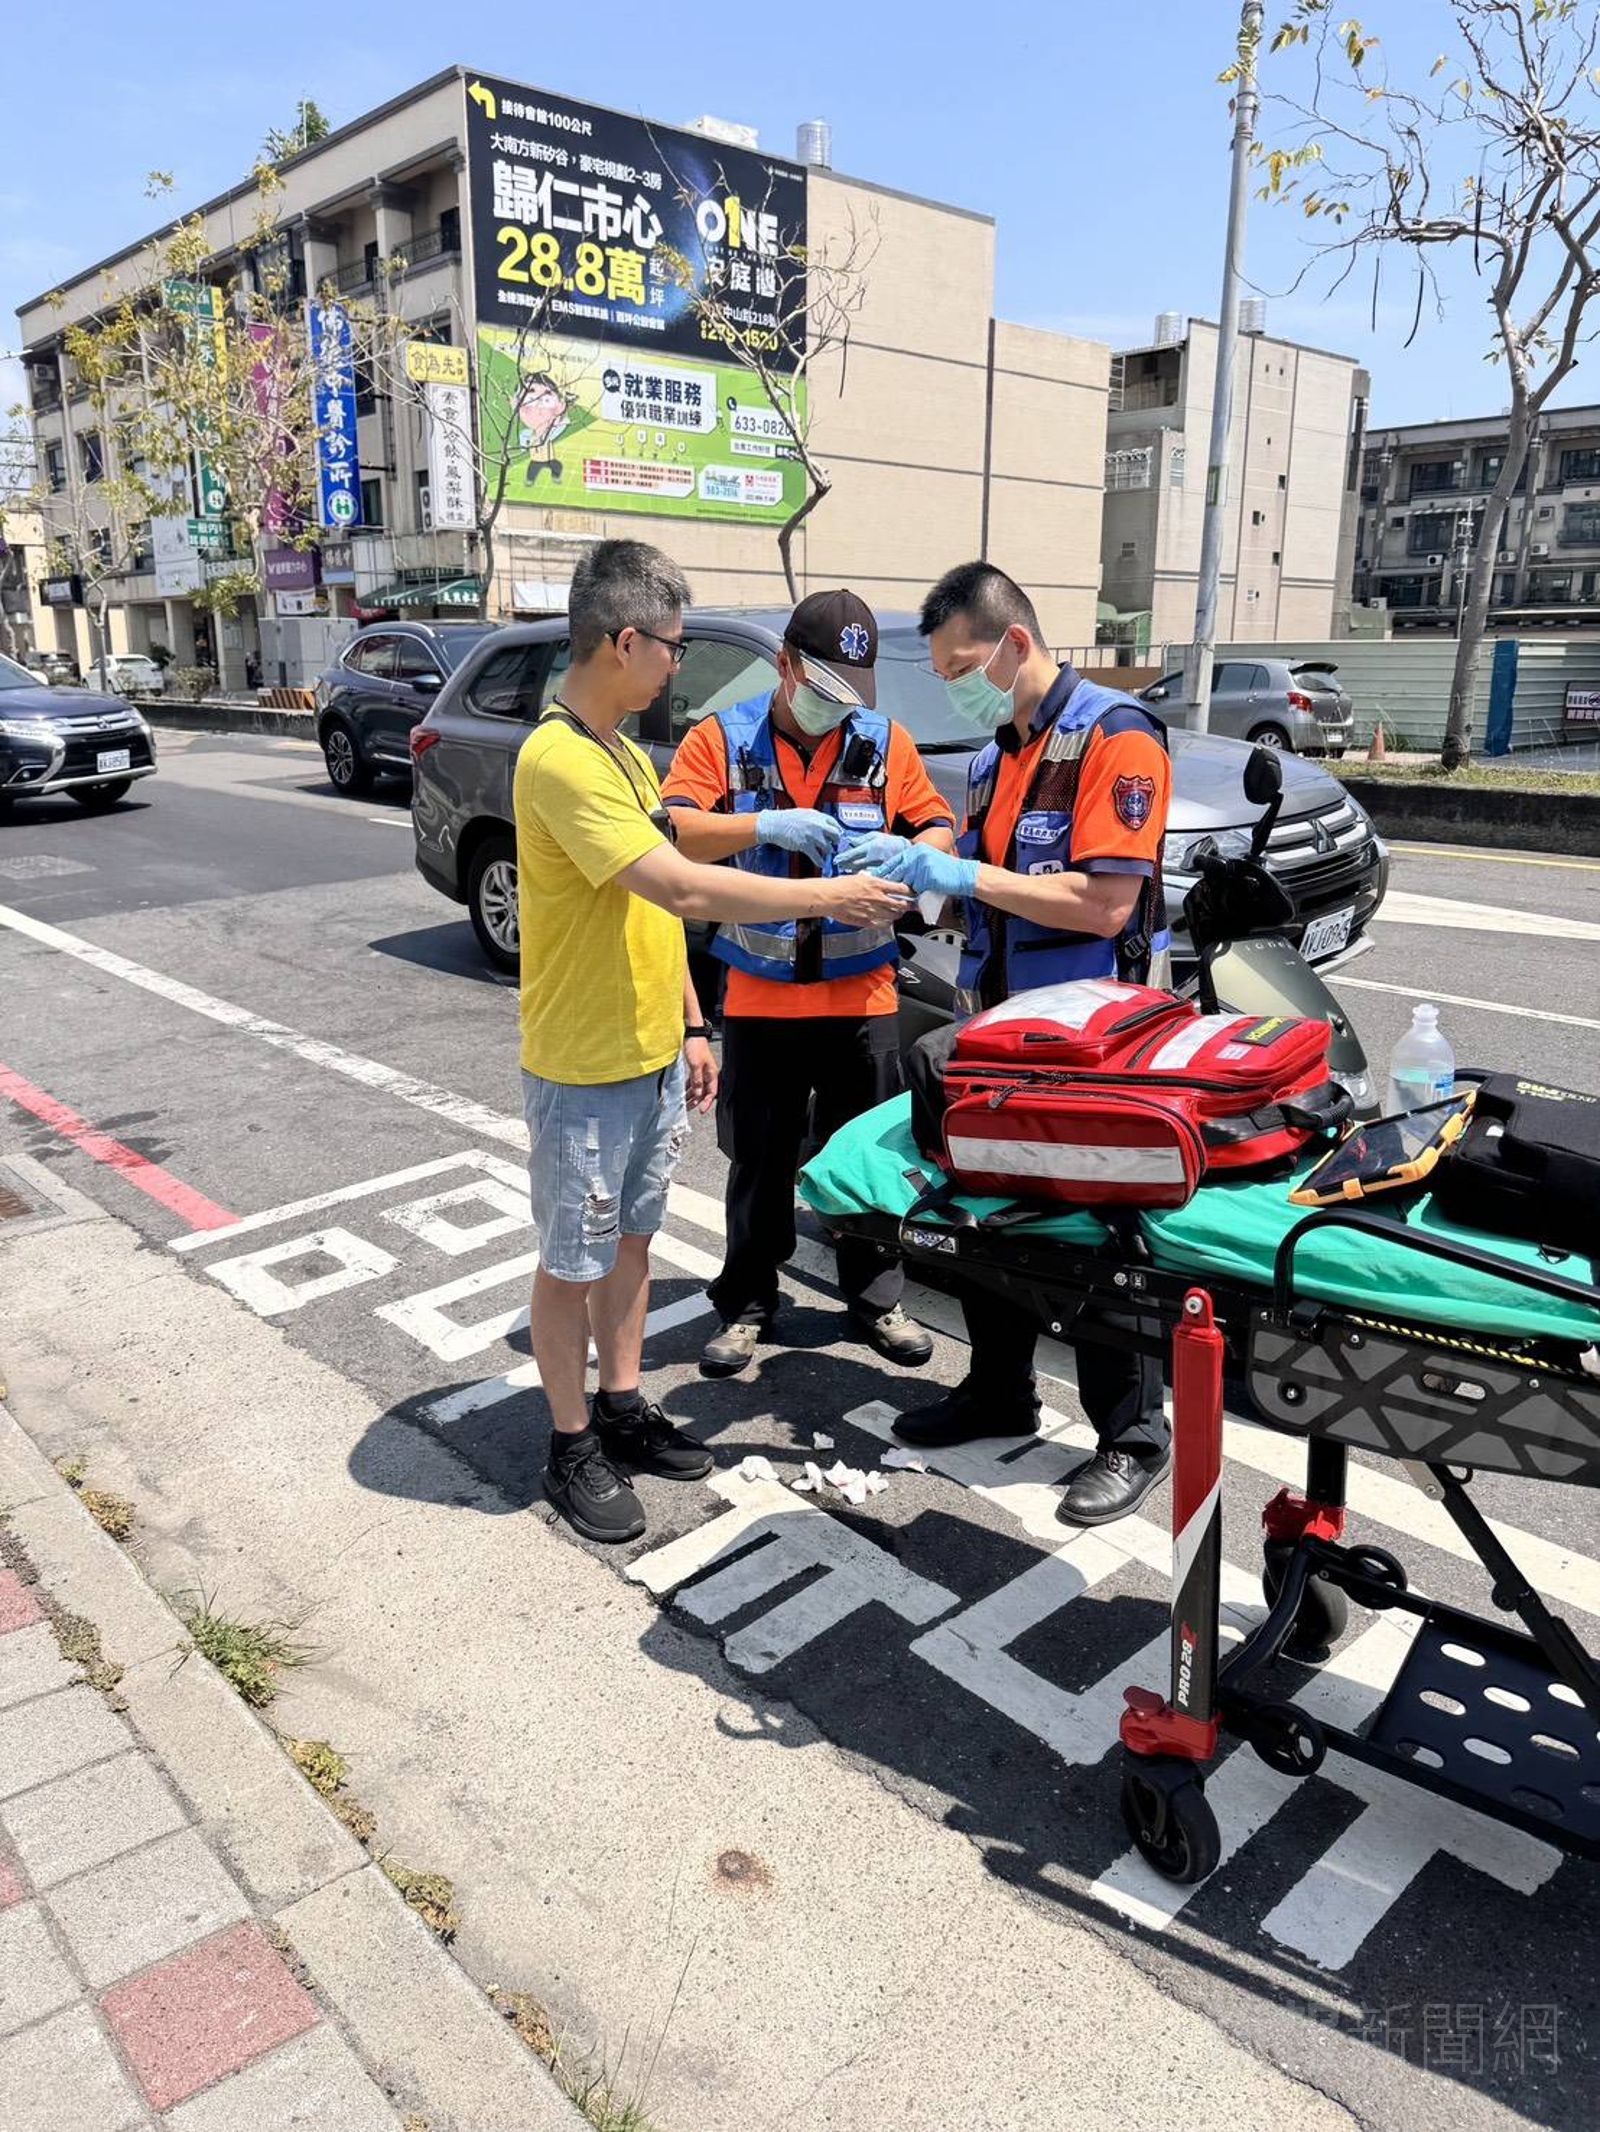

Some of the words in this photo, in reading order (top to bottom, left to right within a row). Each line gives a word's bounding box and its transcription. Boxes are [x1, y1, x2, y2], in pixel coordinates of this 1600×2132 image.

[501, 99, 592, 136] 接待會館100公尺
[493, 159, 664, 249] 歸仁市心
[623, 372, 702, 407] 就業服務
[620, 400, 702, 427] 優質職業訓練
[1177, 1665, 1192, 1707] PRO
